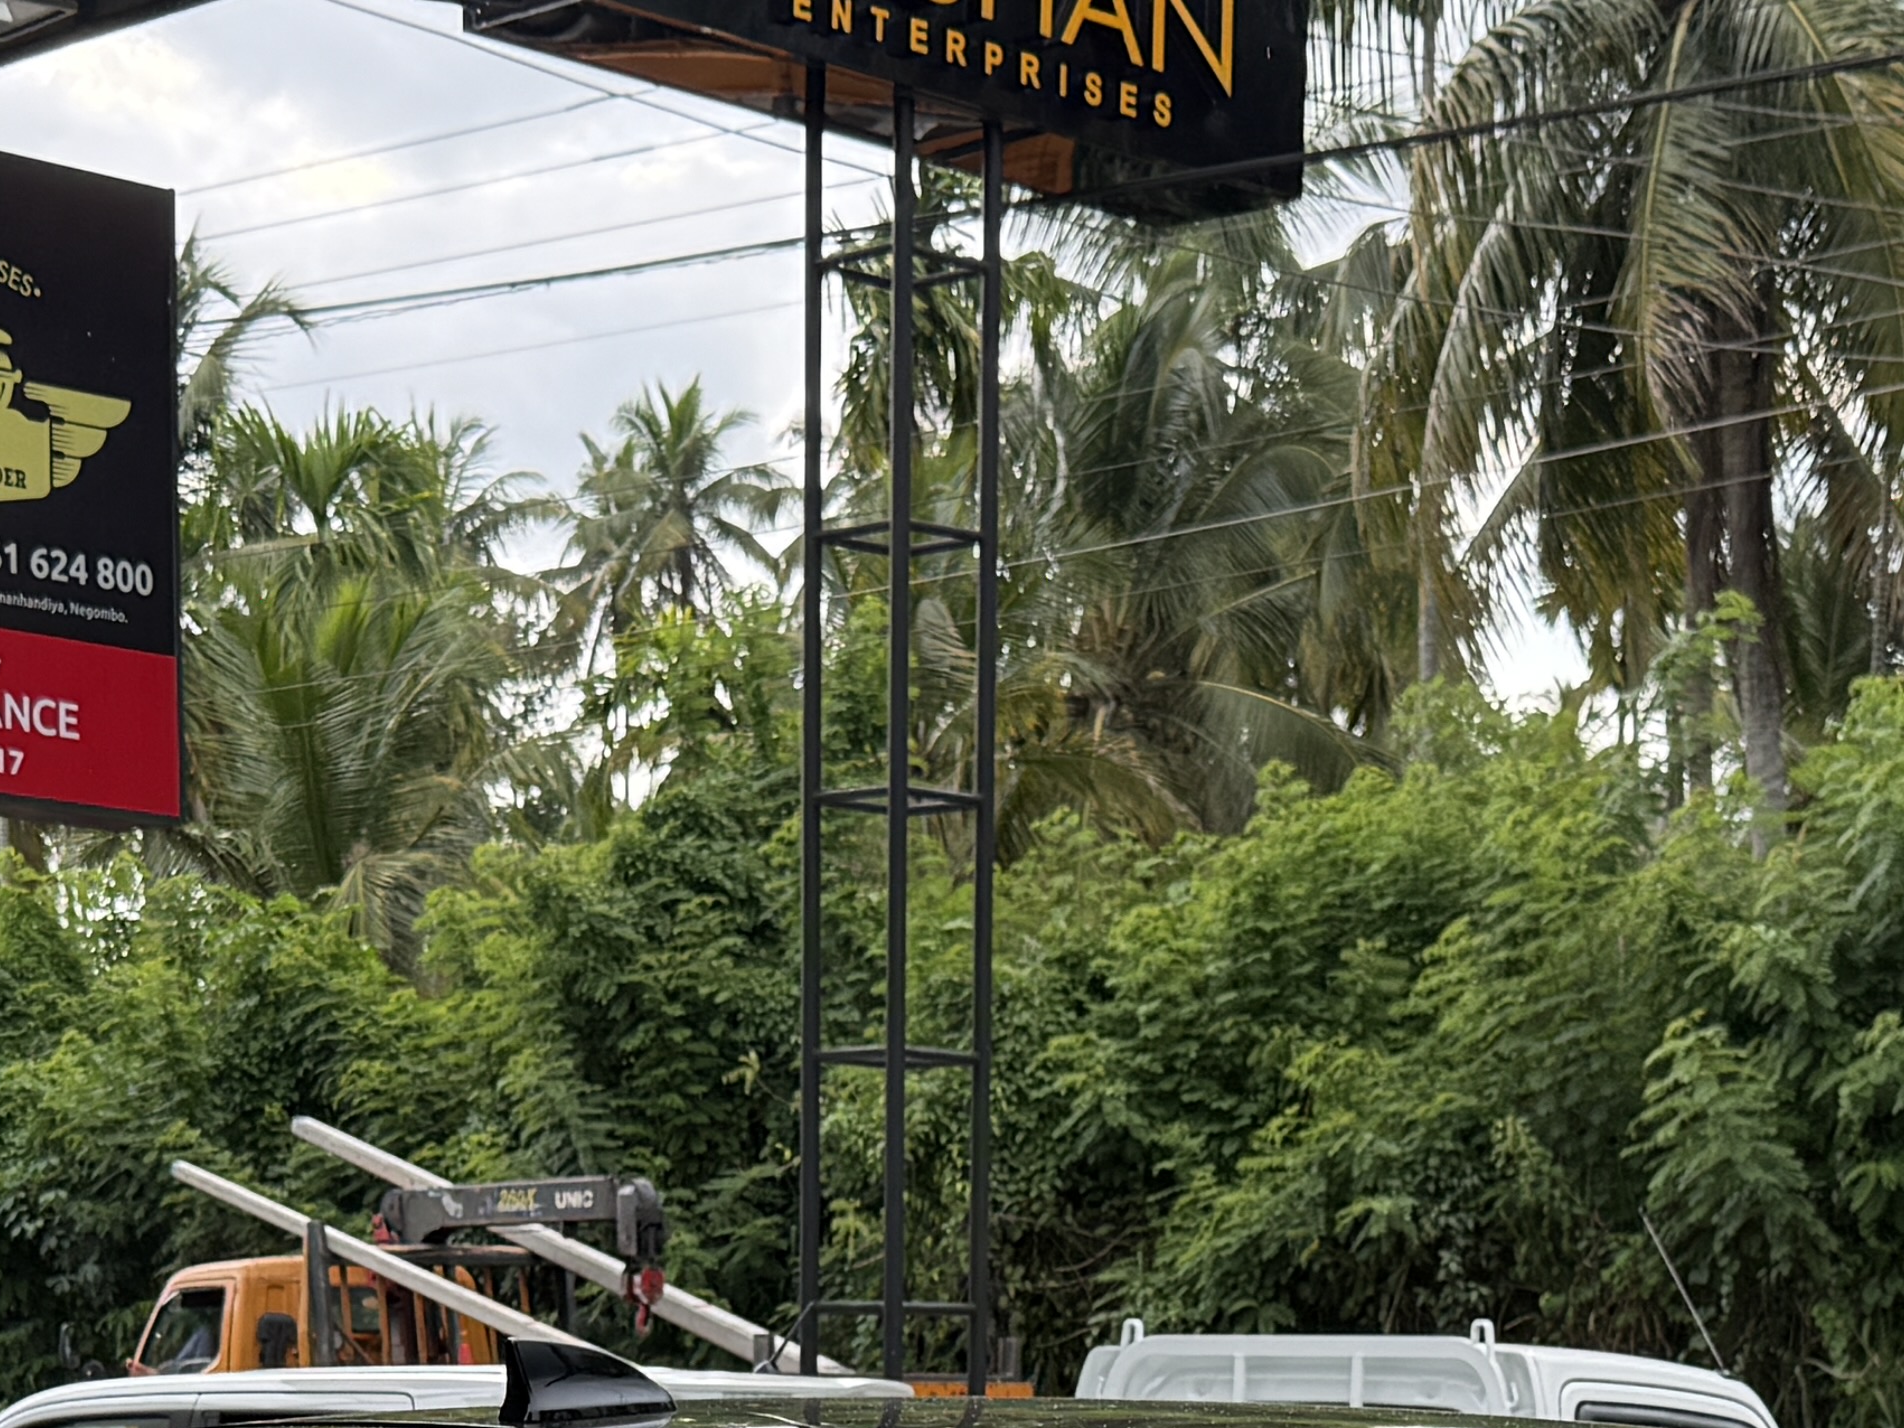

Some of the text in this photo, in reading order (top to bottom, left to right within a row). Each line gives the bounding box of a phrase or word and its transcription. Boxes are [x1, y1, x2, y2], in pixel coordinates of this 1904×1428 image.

[793, 0, 1172, 128] ENTERPRISES
[30, 548, 88, 586] 624
[97, 557, 154, 596] 800
[69, 602, 129, 624] Negombo.
